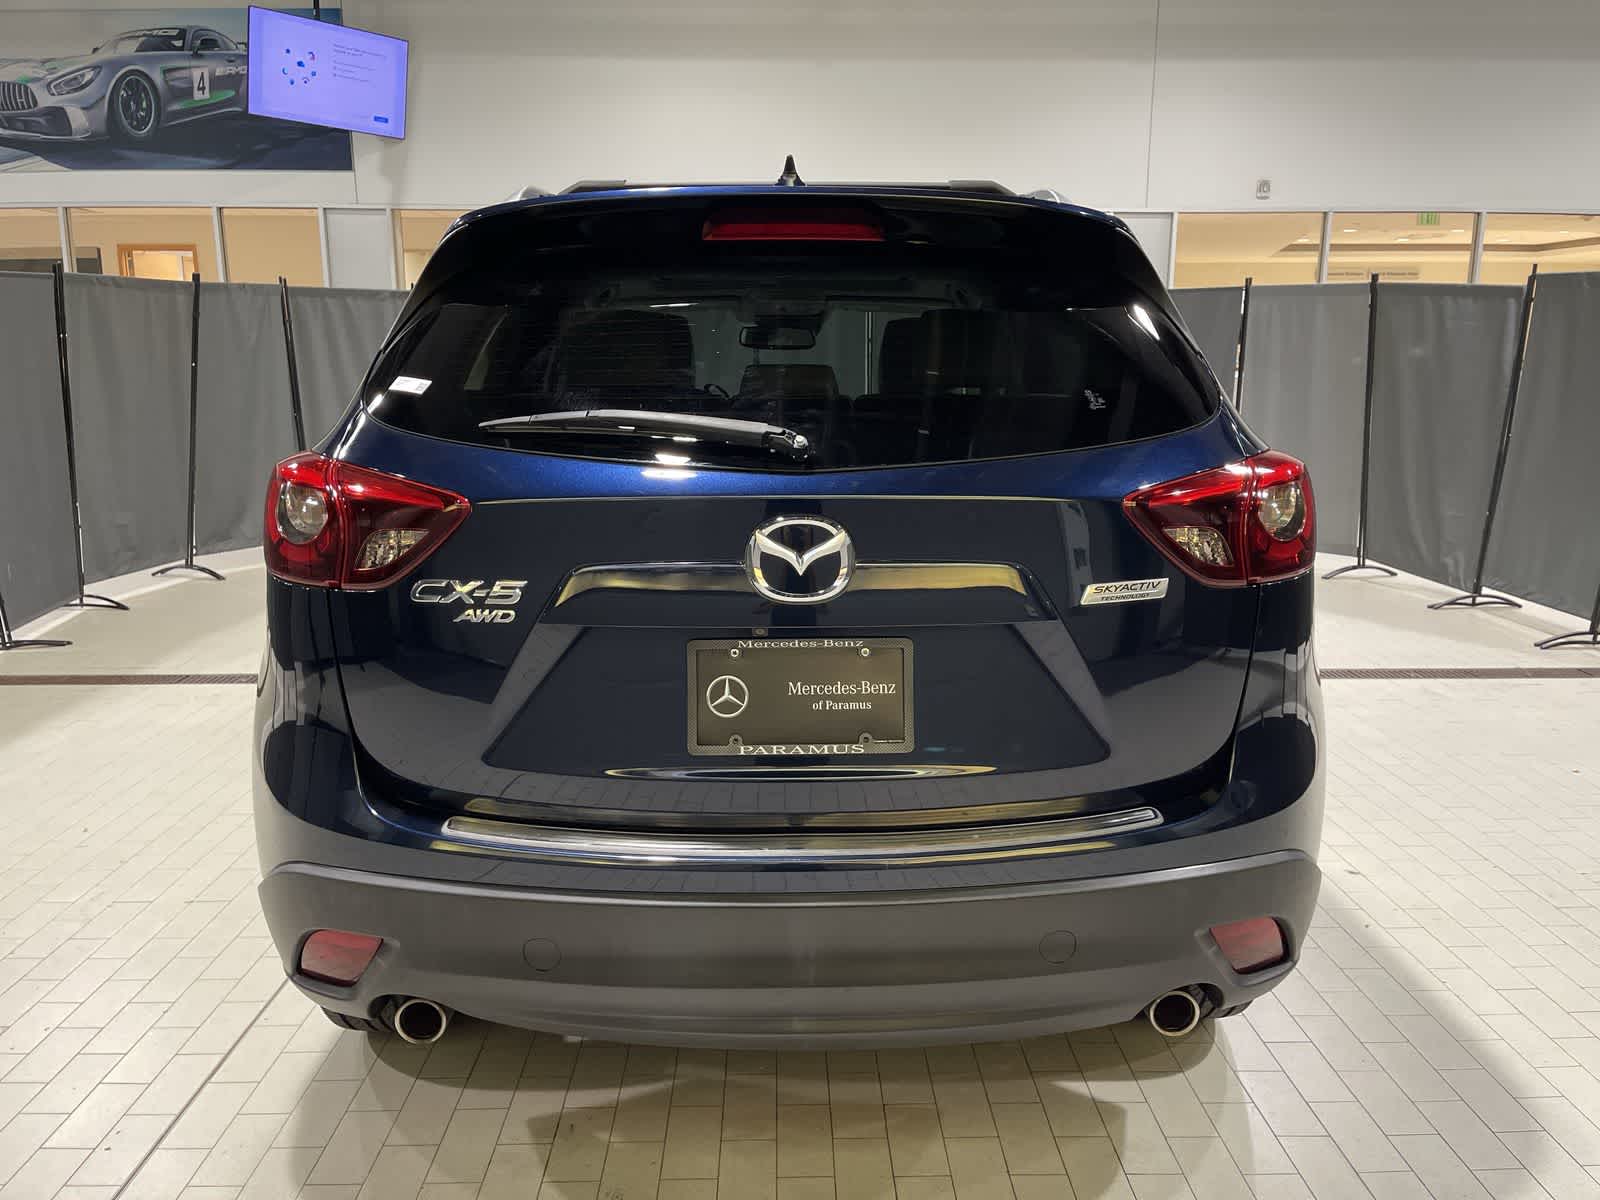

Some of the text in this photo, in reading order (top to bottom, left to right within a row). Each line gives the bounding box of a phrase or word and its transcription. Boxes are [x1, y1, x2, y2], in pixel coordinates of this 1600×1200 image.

[197, 71, 206, 96] 4
[410, 579, 528, 604] CX-5
[1093, 581, 1161, 594] SKYACTIV
[1101, 593, 1150, 601] TECHNOLOGY
[452, 608, 516, 623] AWD
[737, 639, 864, 648] Mercedes-Benz
[787, 680, 896, 696] Mercedes-Benz
[812, 700, 872, 710] of Paramus
[738, 744, 865, 756] PARAMUS
